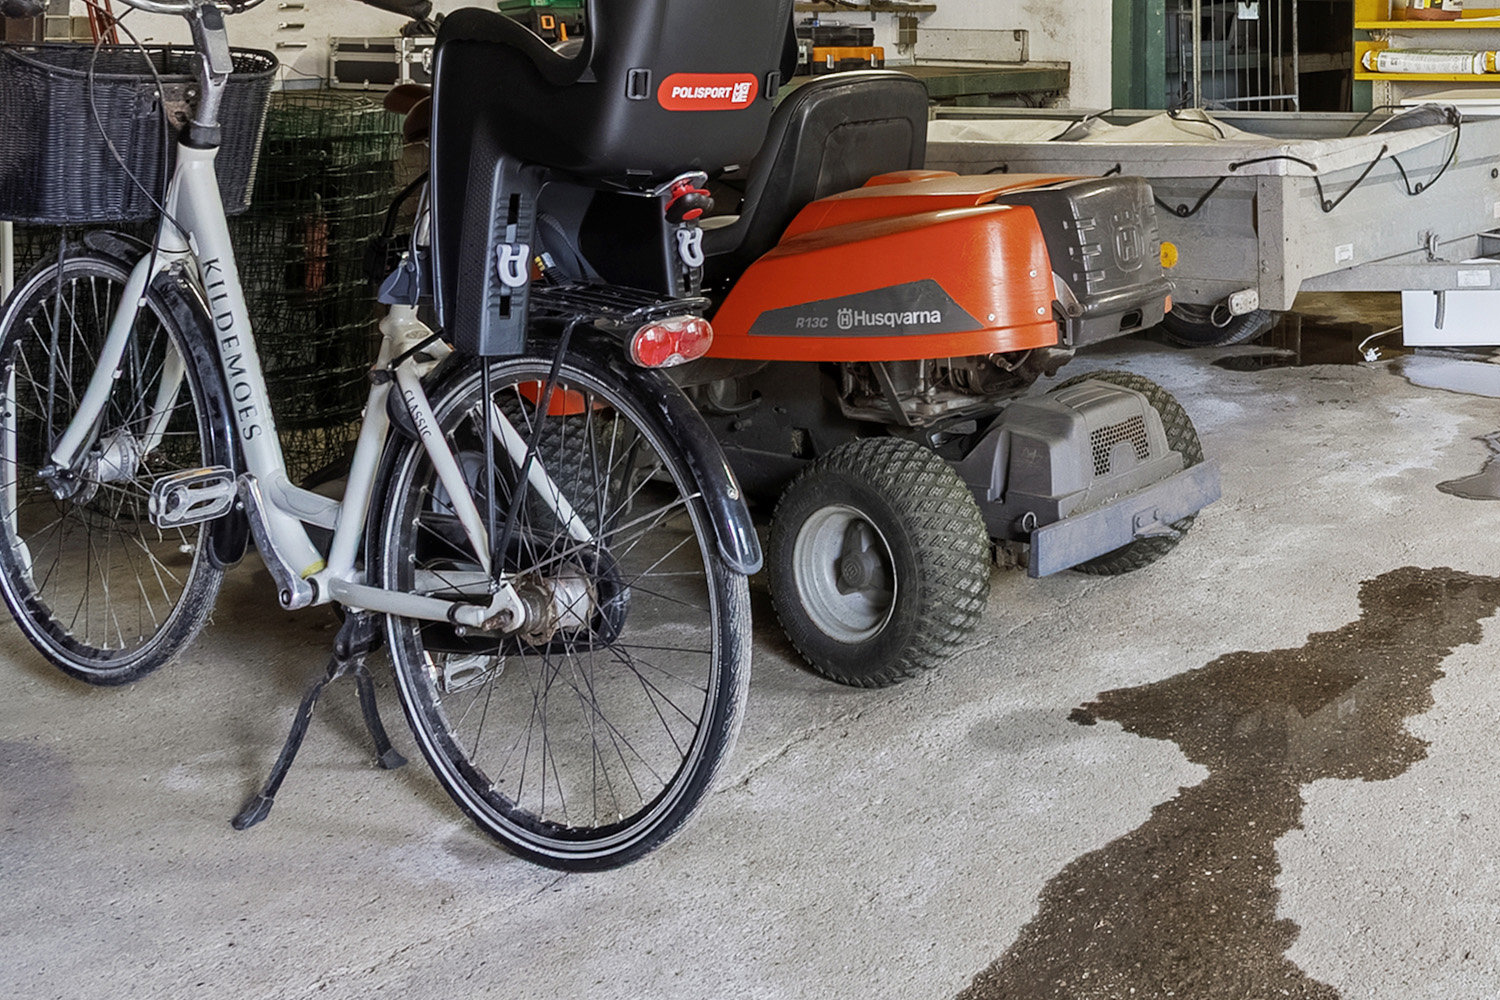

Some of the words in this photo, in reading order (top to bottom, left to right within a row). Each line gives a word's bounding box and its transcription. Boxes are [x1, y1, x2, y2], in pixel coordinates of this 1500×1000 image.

[671, 86, 733, 99] POLISPORT
[795, 317, 829, 329] R13C
[854, 310, 941, 328] Husqvarna
[202, 257, 263, 441] KILDEMOES
[404, 389, 432, 437] CLASSIC
